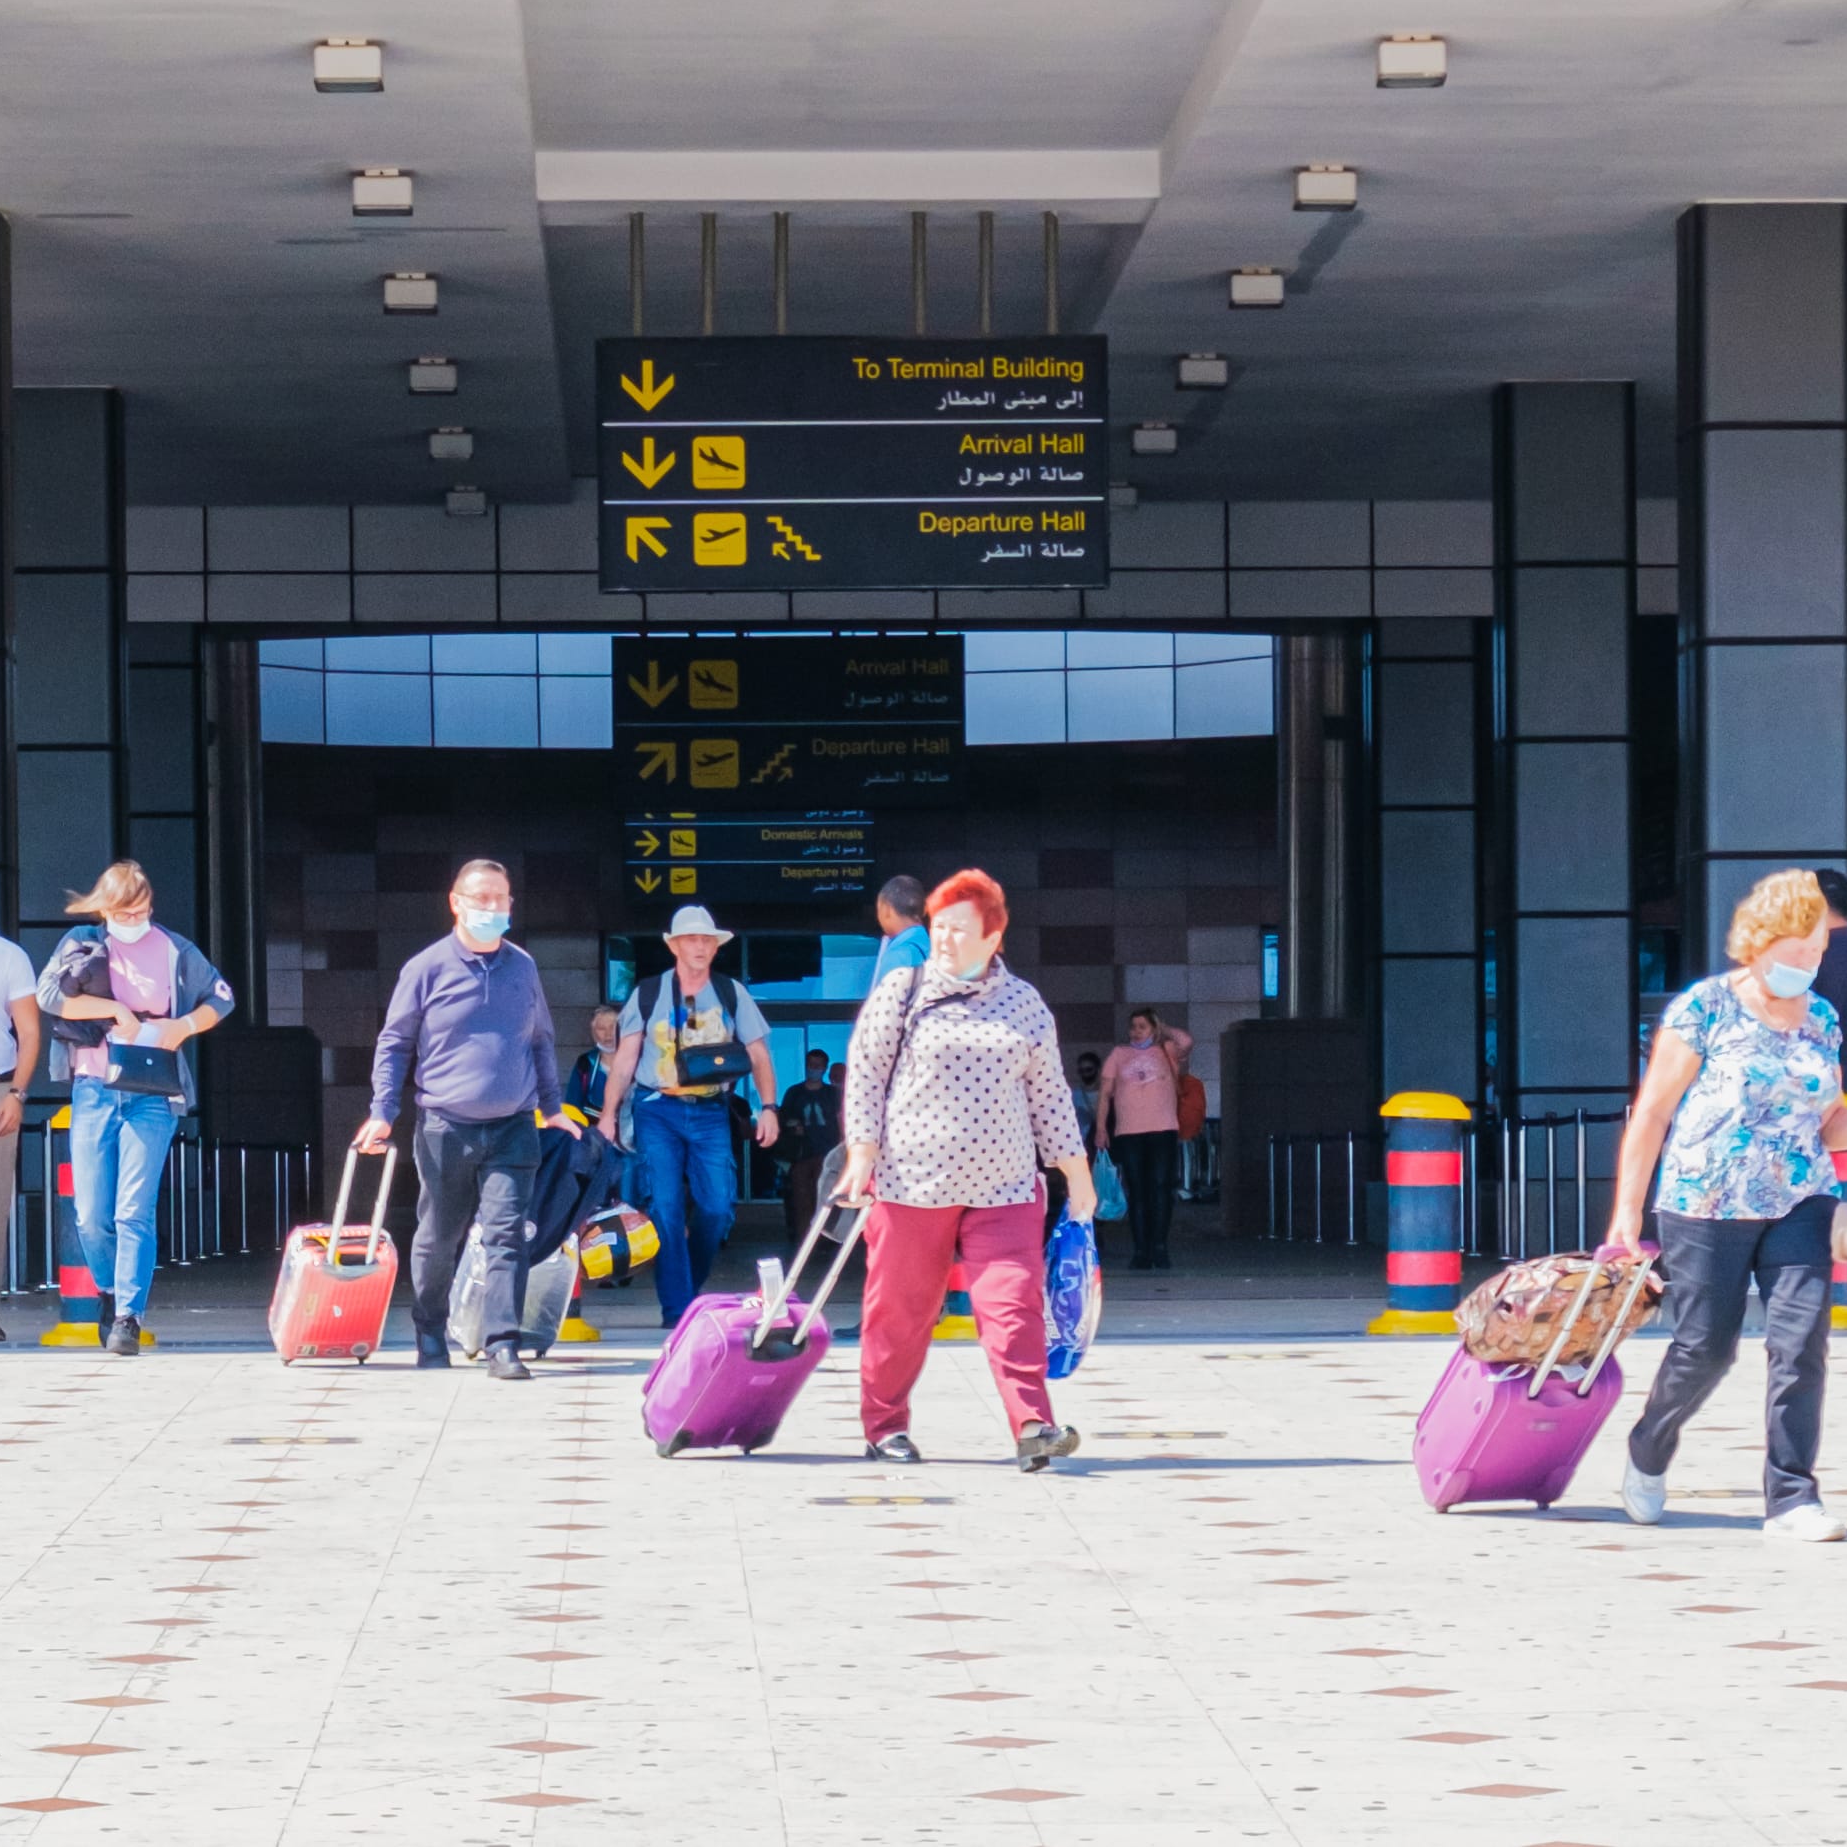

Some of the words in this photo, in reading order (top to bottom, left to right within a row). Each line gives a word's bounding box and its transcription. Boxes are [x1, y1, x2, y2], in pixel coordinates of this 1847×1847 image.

[853, 358, 881, 379] To
[887, 357, 985, 379] Terminal
[992, 356, 1085, 383] Building
[936, 391, 996, 410] المطار
[1004, 390, 1047, 410] مبنى
[959, 433, 1033, 455] Arrival
[1040, 433, 1085, 454] Hall
[958, 466, 1032, 486] الوصول
[1039, 466, 1085, 482] صالة
[918, 511, 1034, 538] Departure
[1041, 511, 1085, 532] Hall
[980, 543, 1033, 563] السفر
[1040, 542, 1086, 558] صالة
[845, 659, 907, 675] Arrival
[912, 658, 950, 675] Hall
[811, 738, 907, 759] Departure
[913, 737, 950, 755] Hall
[761, 829, 817, 841] Domestic
[819, 829, 864, 840] Arrivals
[781, 866, 839, 881] Departure
[842, 865, 865, 878] Hall
